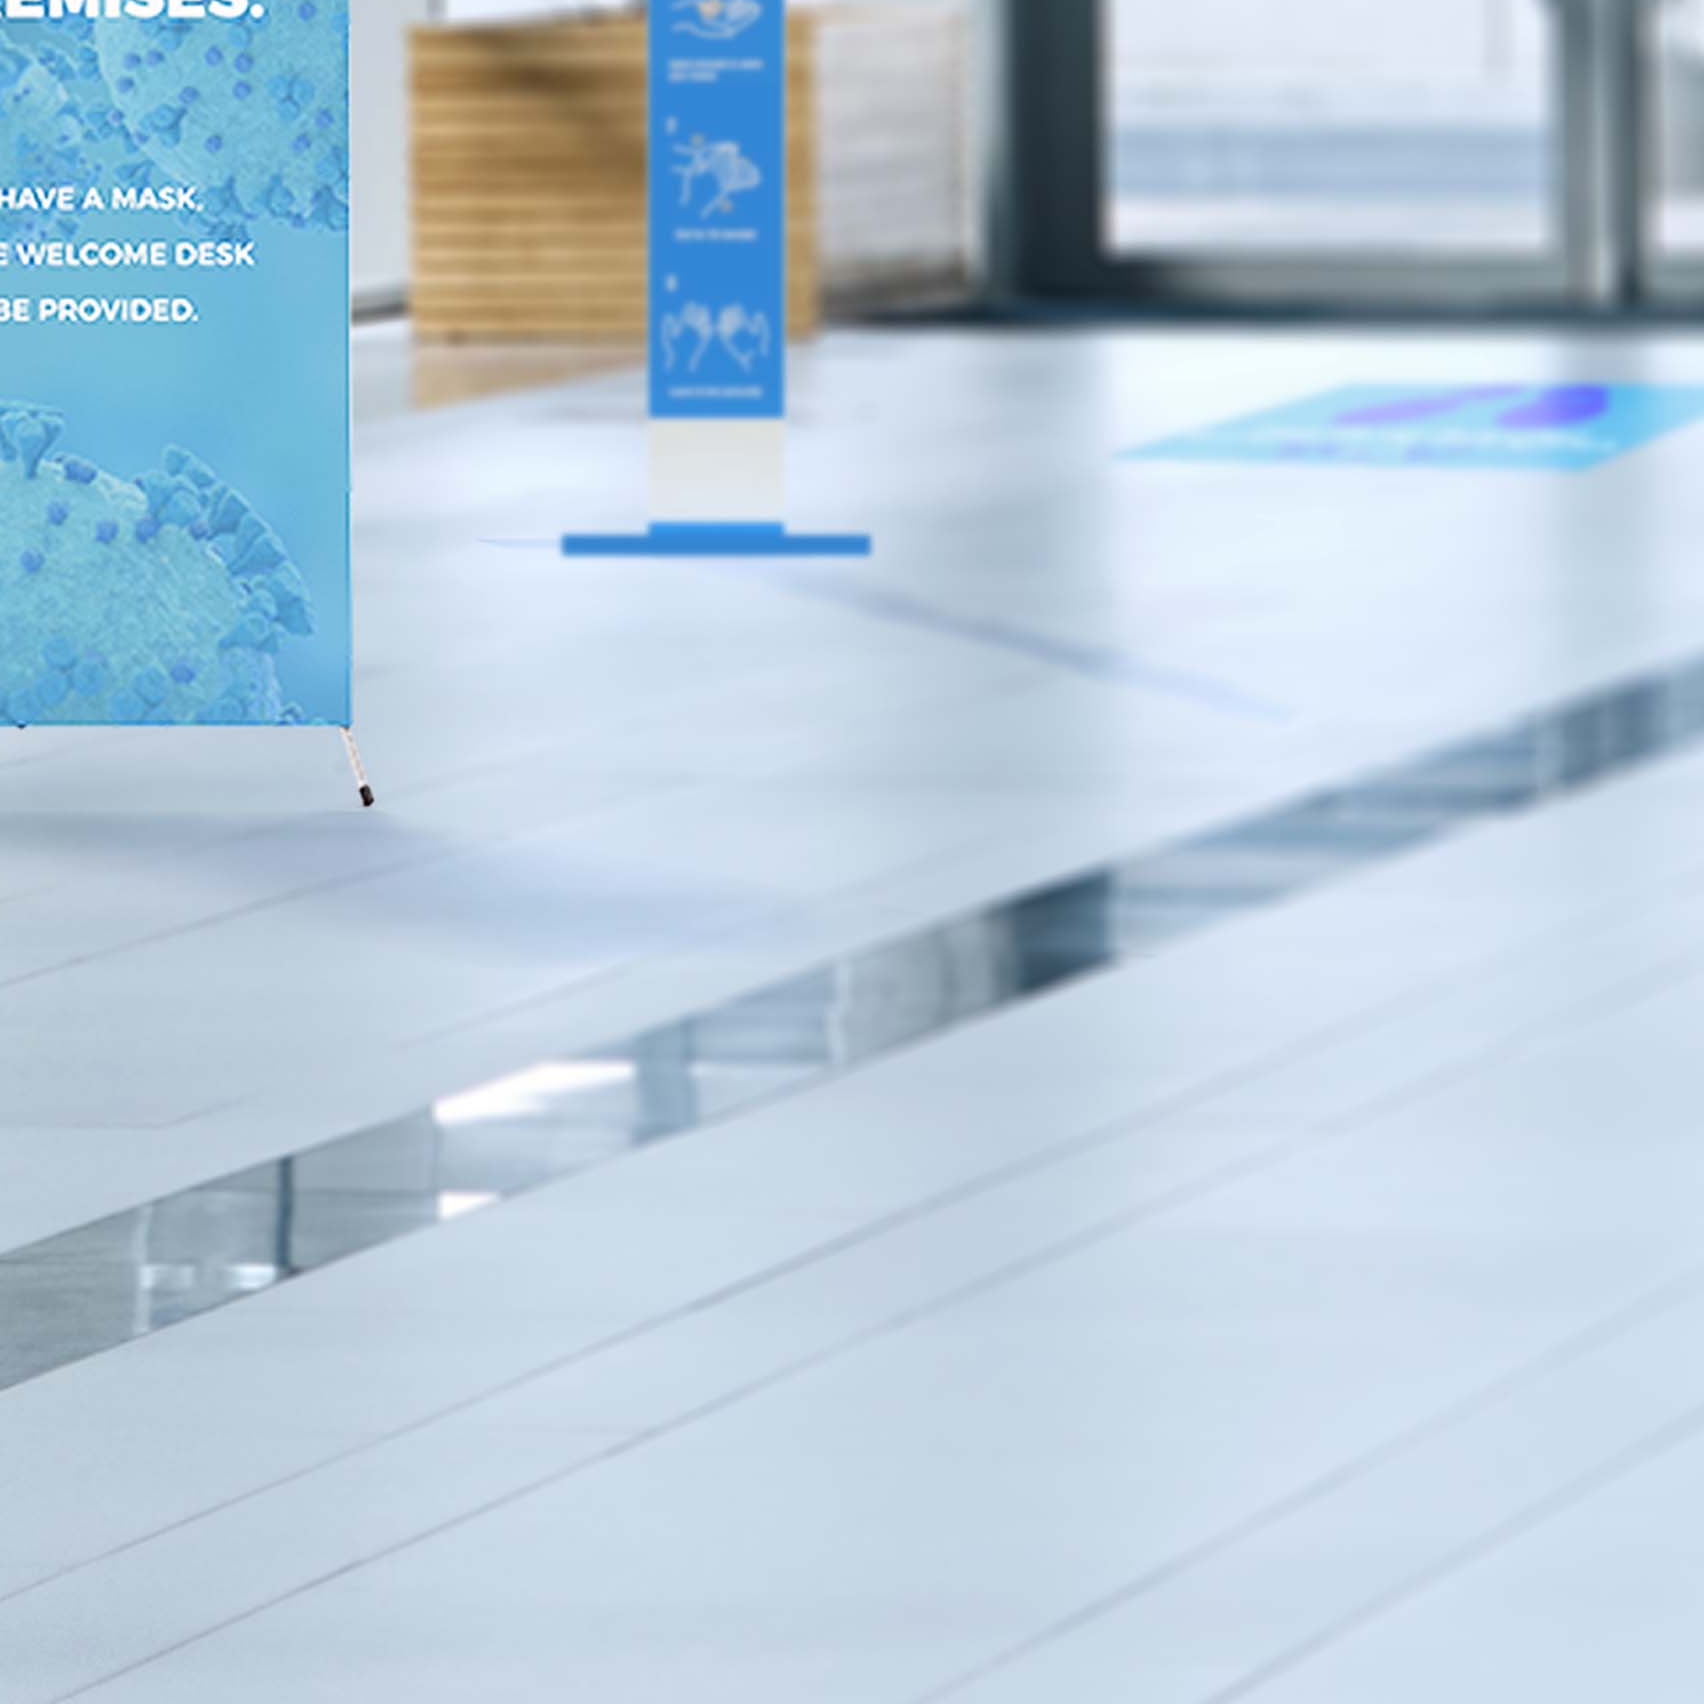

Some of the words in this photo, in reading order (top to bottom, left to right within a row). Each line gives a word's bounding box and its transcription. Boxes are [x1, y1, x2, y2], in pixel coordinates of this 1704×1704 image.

[82, 186, 105, 211] A
[16, 242, 167, 267] WELCOME
[175, 242, 255, 267] DESK
[39, 298, 198, 323] PROVIDED.
